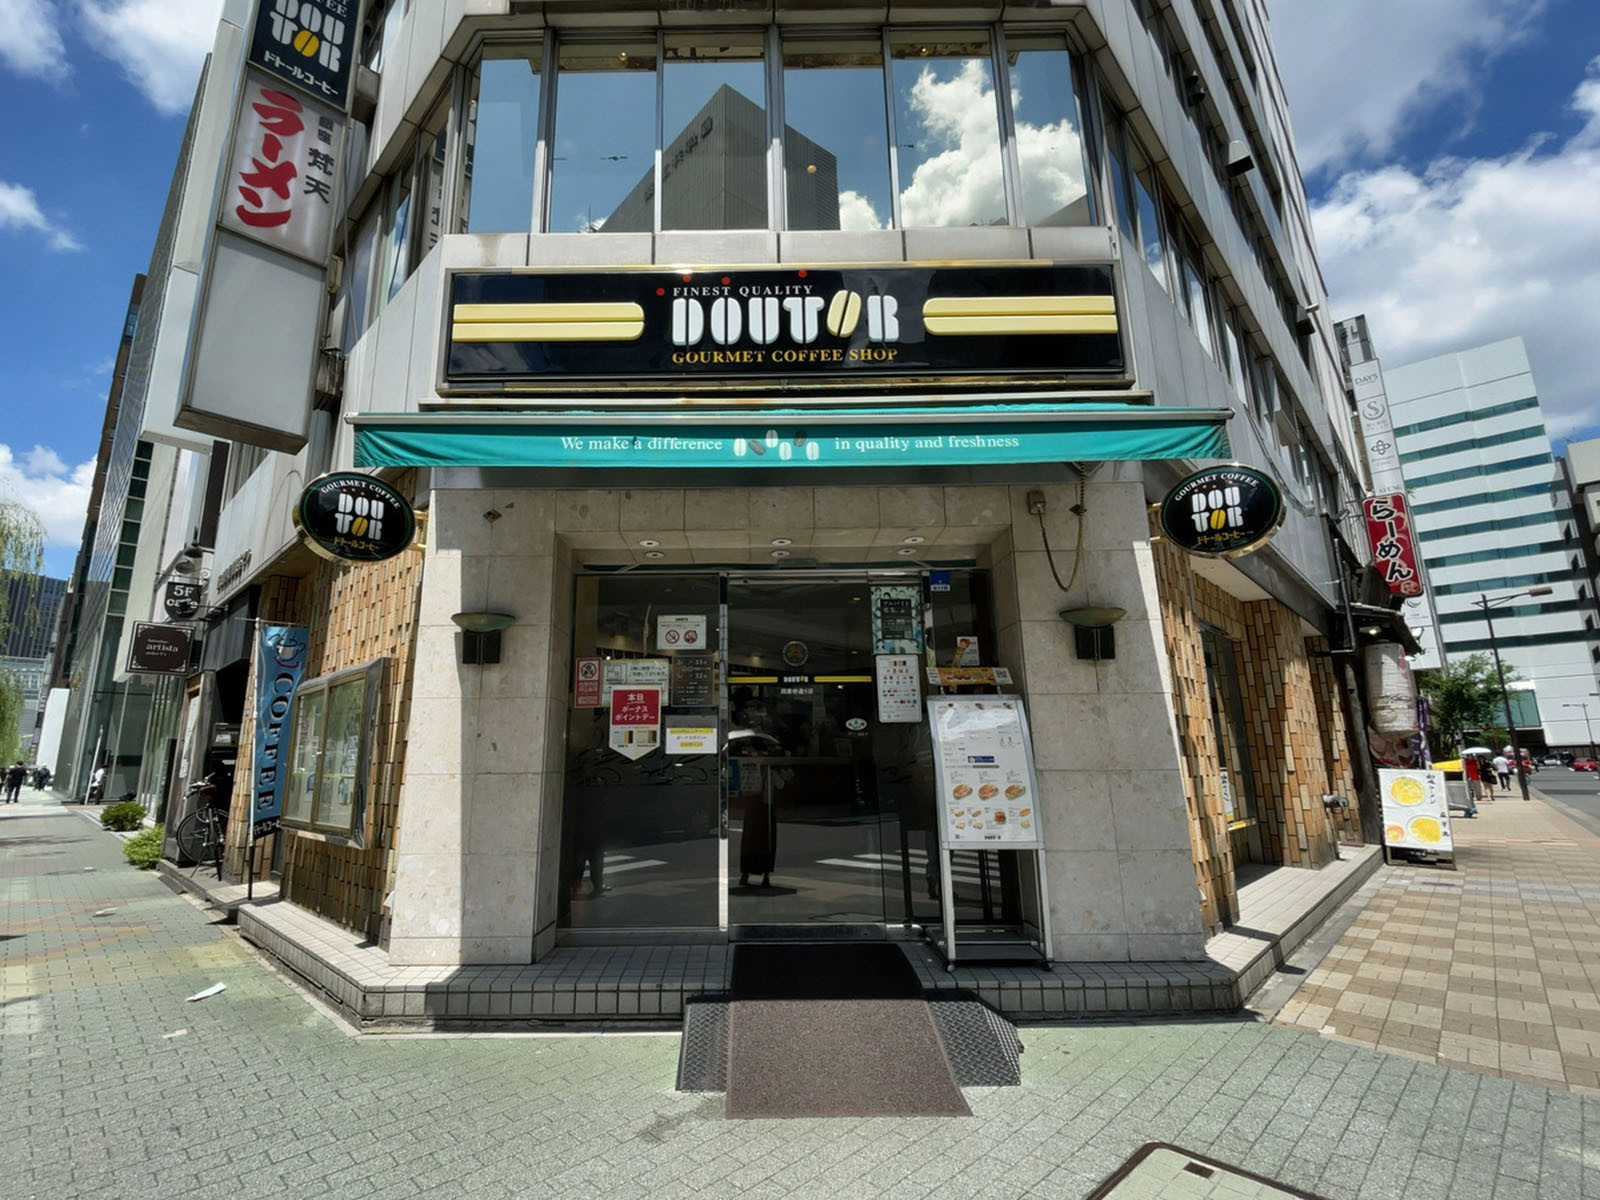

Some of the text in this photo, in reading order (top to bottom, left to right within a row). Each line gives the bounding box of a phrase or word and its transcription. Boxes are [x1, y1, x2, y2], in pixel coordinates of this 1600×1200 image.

[269, 10, 342, 73] TOR
[263, 49, 340, 96] ドトールコーヒー
[235, 87, 305, 228] ラーメン
[672, 284, 814, 297] FINEST QUALITY
[671, 289, 900, 347] DOUTOR
[671, 348, 899, 364] GOURMET COFFEE SHOP
[1354, 373, 1379, 385] DAYS
[560, 436, 723, 450] We make a difference
[834, 435, 1020, 453] in quality and freshness
[320, 479, 401, 509] GOURMET COFFEE
[1174, 472, 1260, 502] GOURMET COFFEE
[338, 493, 385, 520] DOU
[1191, 486, 1241, 513] DOU
[334, 512, 383, 541] TOR
[1191, 506, 1244, 533] TOR
[333, 536, 380, 552] ドトールコーヒー
[1197, 530, 1246, 545] ドトールコーヒー
[1371, 498, 1414, 582] らーめん
[173, 584, 194, 597] 5F
[146, 643, 179, 652] artista
[627, 693, 644, 701] 本日
[615, 712, 656, 721] ポイントデー
[621, 704, 649, 713] ボーナス
[256, 672, 295, 813] COFFEE
